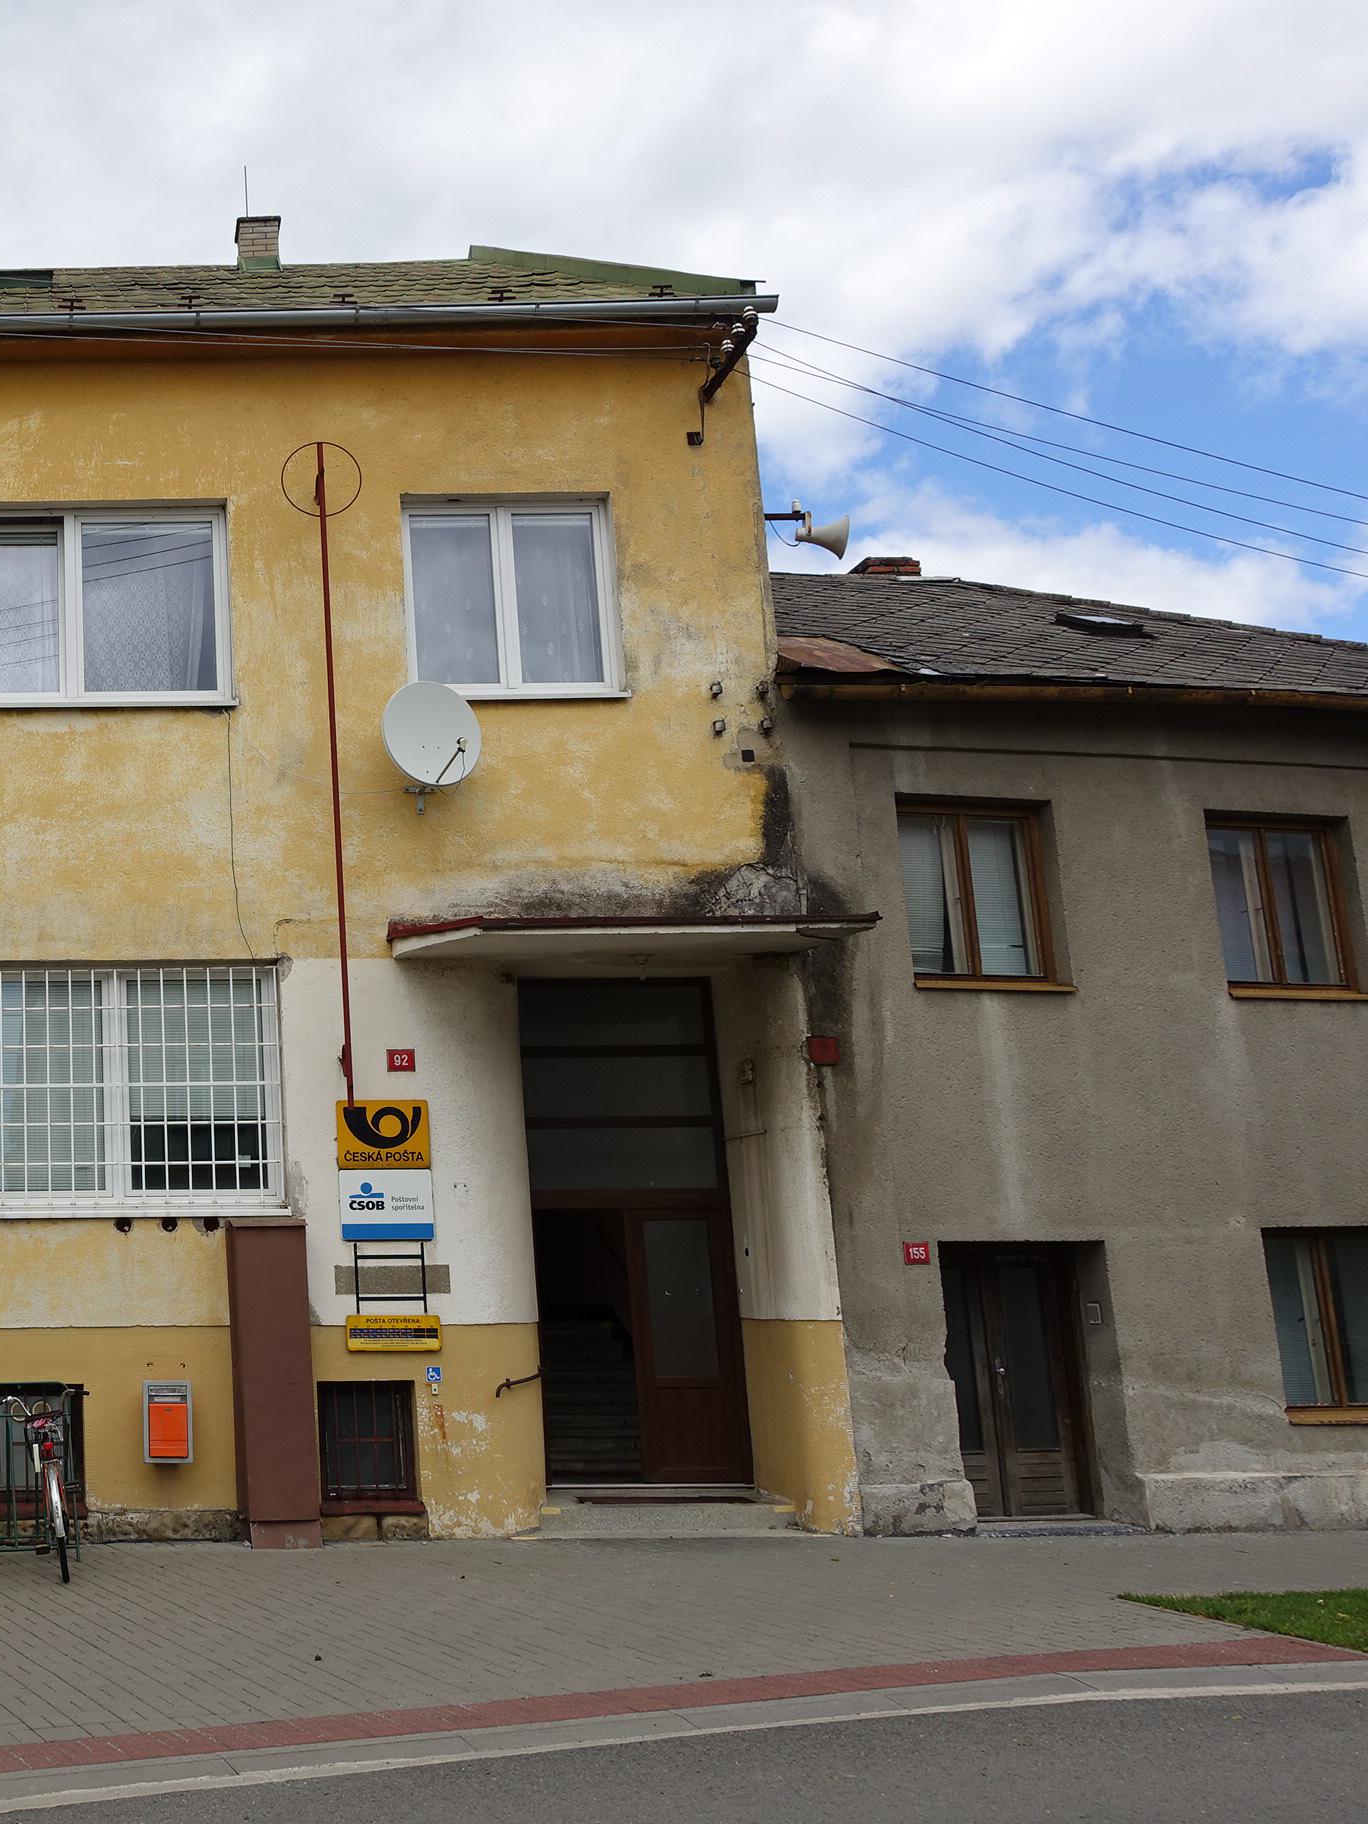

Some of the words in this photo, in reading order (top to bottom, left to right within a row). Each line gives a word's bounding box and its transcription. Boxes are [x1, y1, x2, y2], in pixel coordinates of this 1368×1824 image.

[393, 1054, 409, 1066] 92
[343, 1150, 383, 1162] ČESKÁ
[385, 1150, 424, 1162] POŠTA
[349, 1199, 386, 1211] ČSOB
[391, 1195, 420, 1203] Poštovní
[391, 1203, 425, 1211] spořitelna
[909, 1247, 926, 1260] 155
